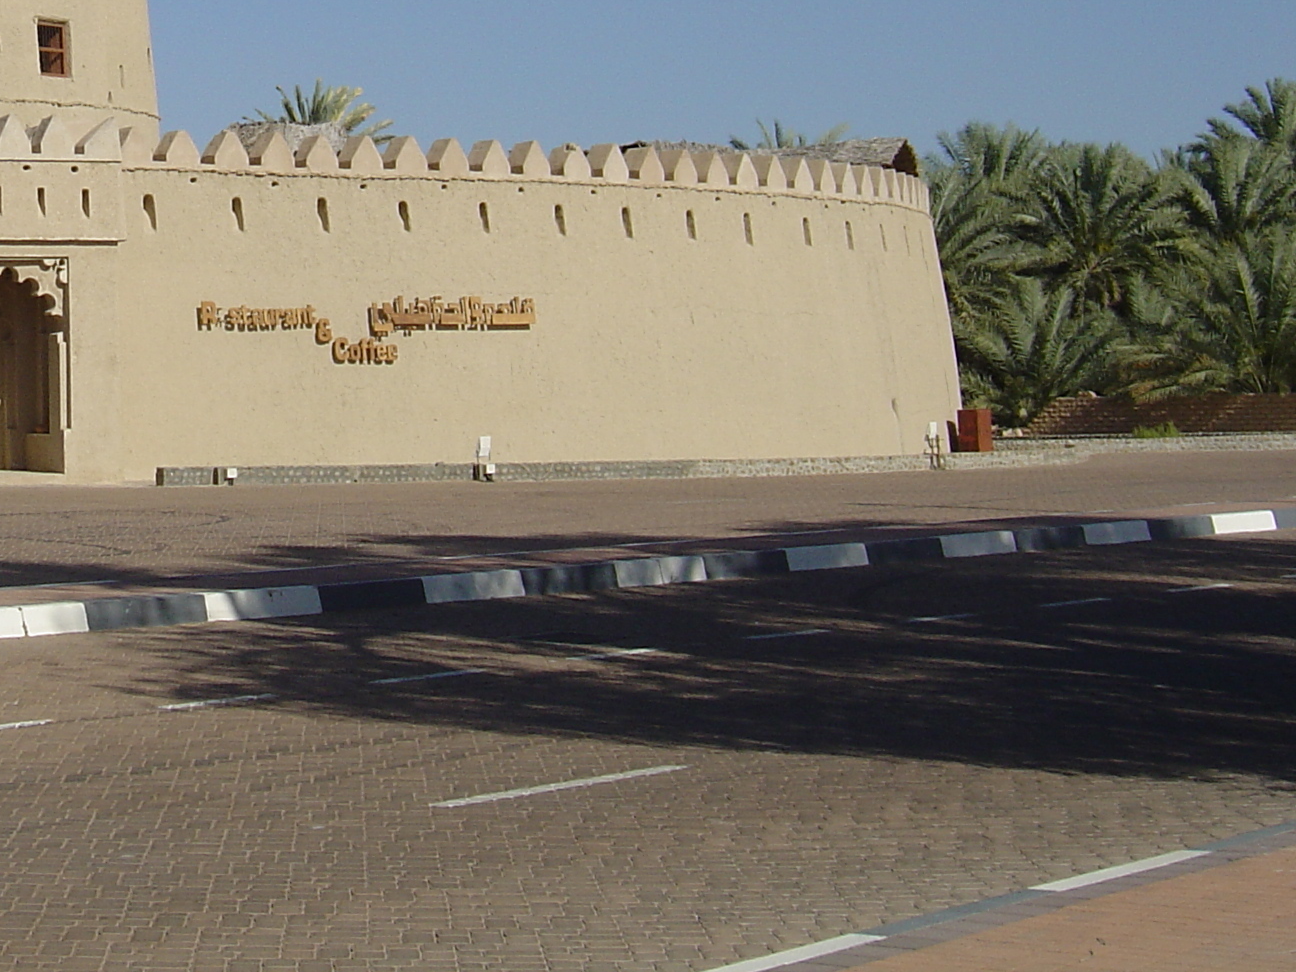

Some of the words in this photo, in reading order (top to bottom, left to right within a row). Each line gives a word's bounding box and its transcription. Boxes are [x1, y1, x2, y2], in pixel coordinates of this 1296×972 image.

[198, 301, 316, 329] Rstaurant
[316, 318, 332, 343] &
[333, 337, 398, 362] Coffee
